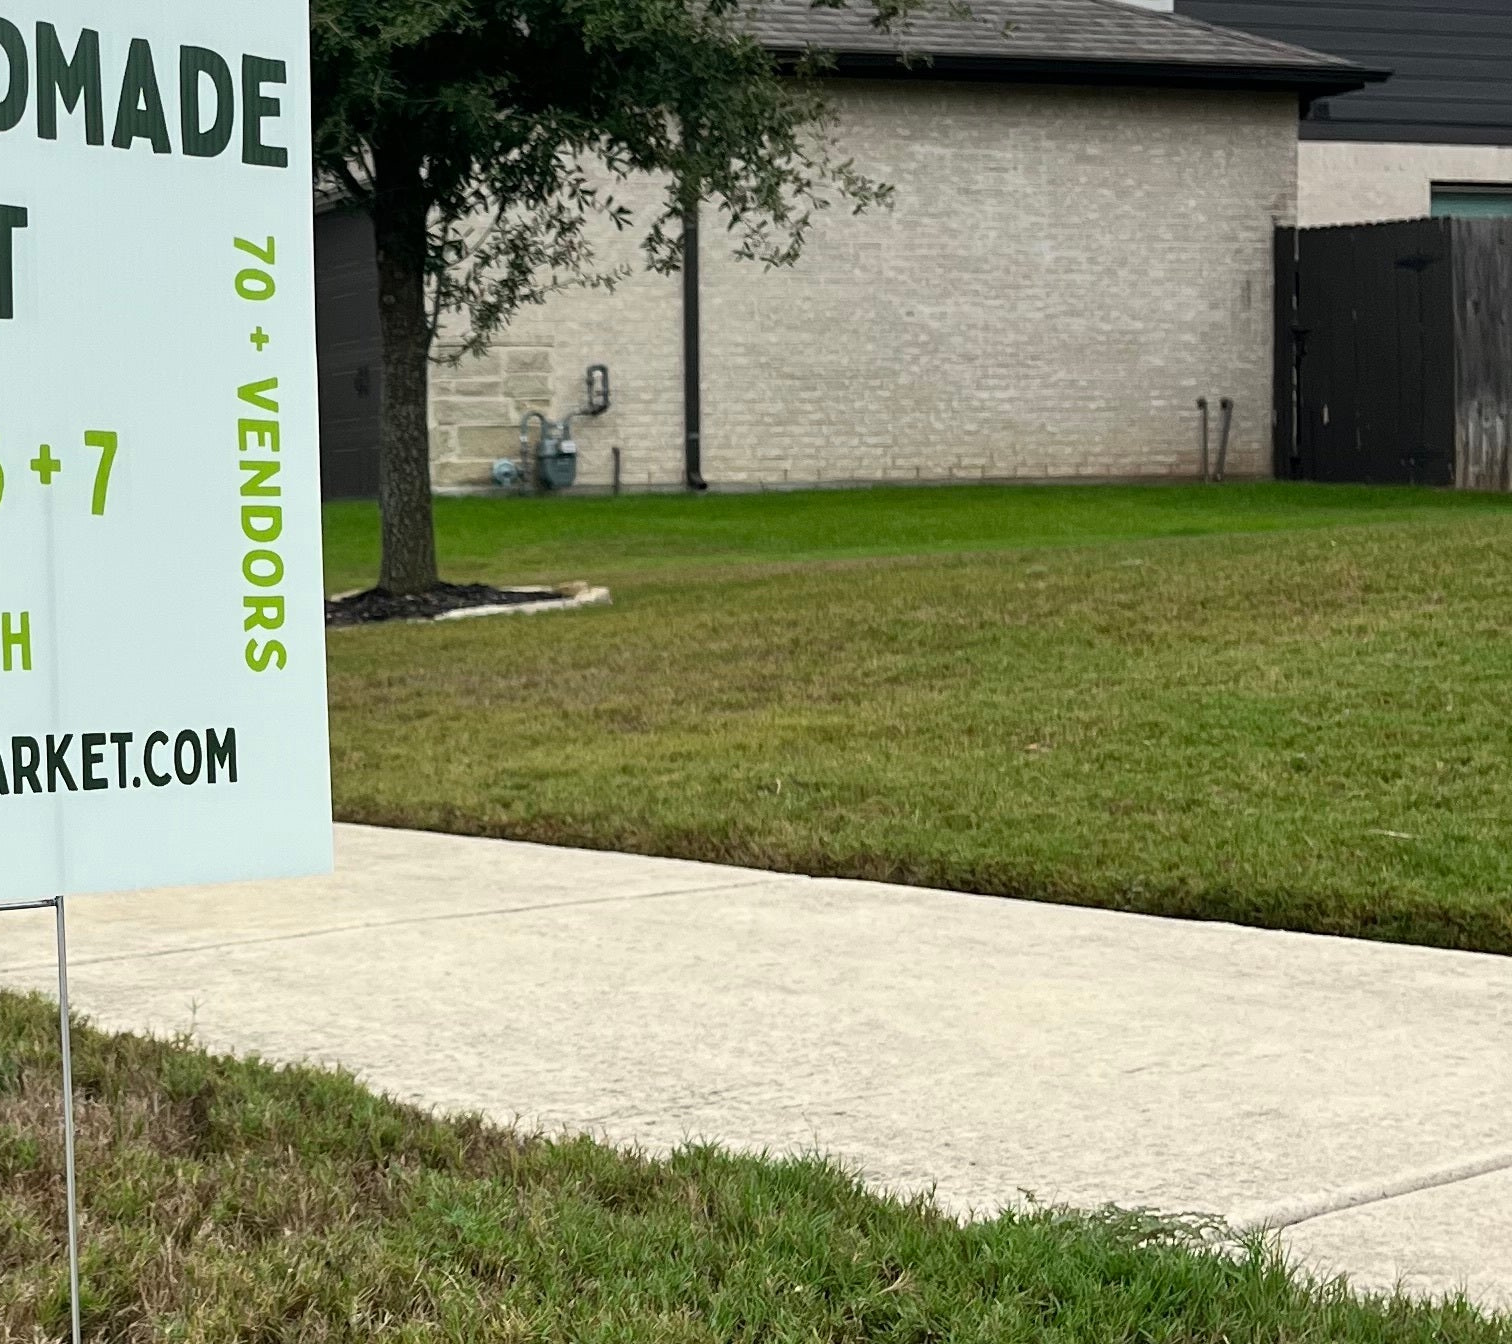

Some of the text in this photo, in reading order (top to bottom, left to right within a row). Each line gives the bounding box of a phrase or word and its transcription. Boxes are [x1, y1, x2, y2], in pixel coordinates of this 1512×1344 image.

[29, 444, 62, 486] +
[83, 429, 118, 516] 7
[233, 236, 288, 673] 70 + VENDORS
